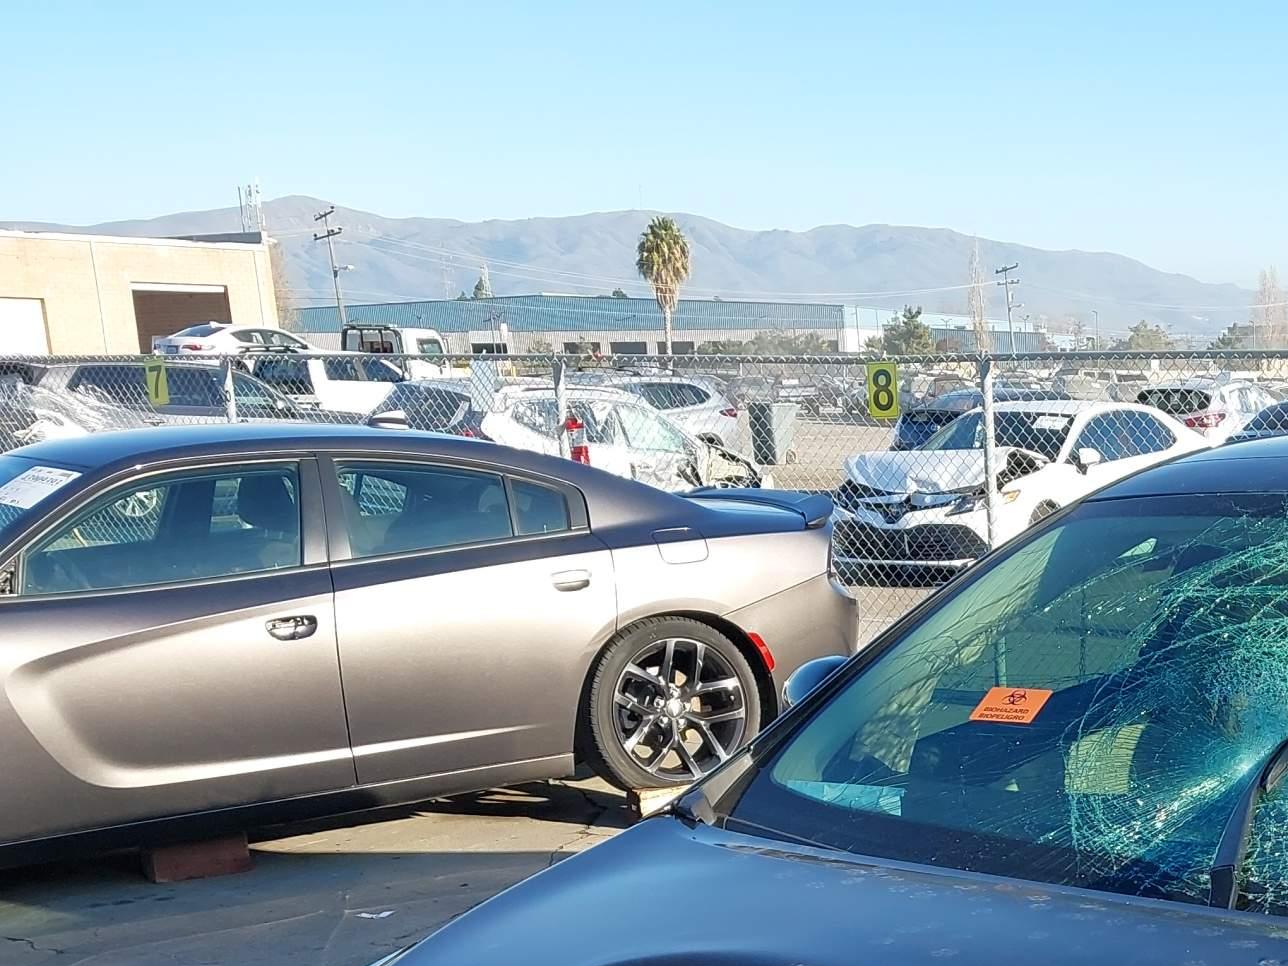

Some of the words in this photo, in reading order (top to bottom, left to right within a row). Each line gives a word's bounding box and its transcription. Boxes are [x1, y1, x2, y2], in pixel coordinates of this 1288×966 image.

[148, 365, 162, 400] 7
[873, 369, 894, 411] 8
[983, 706, 1030, 714] BIOHAZARD
